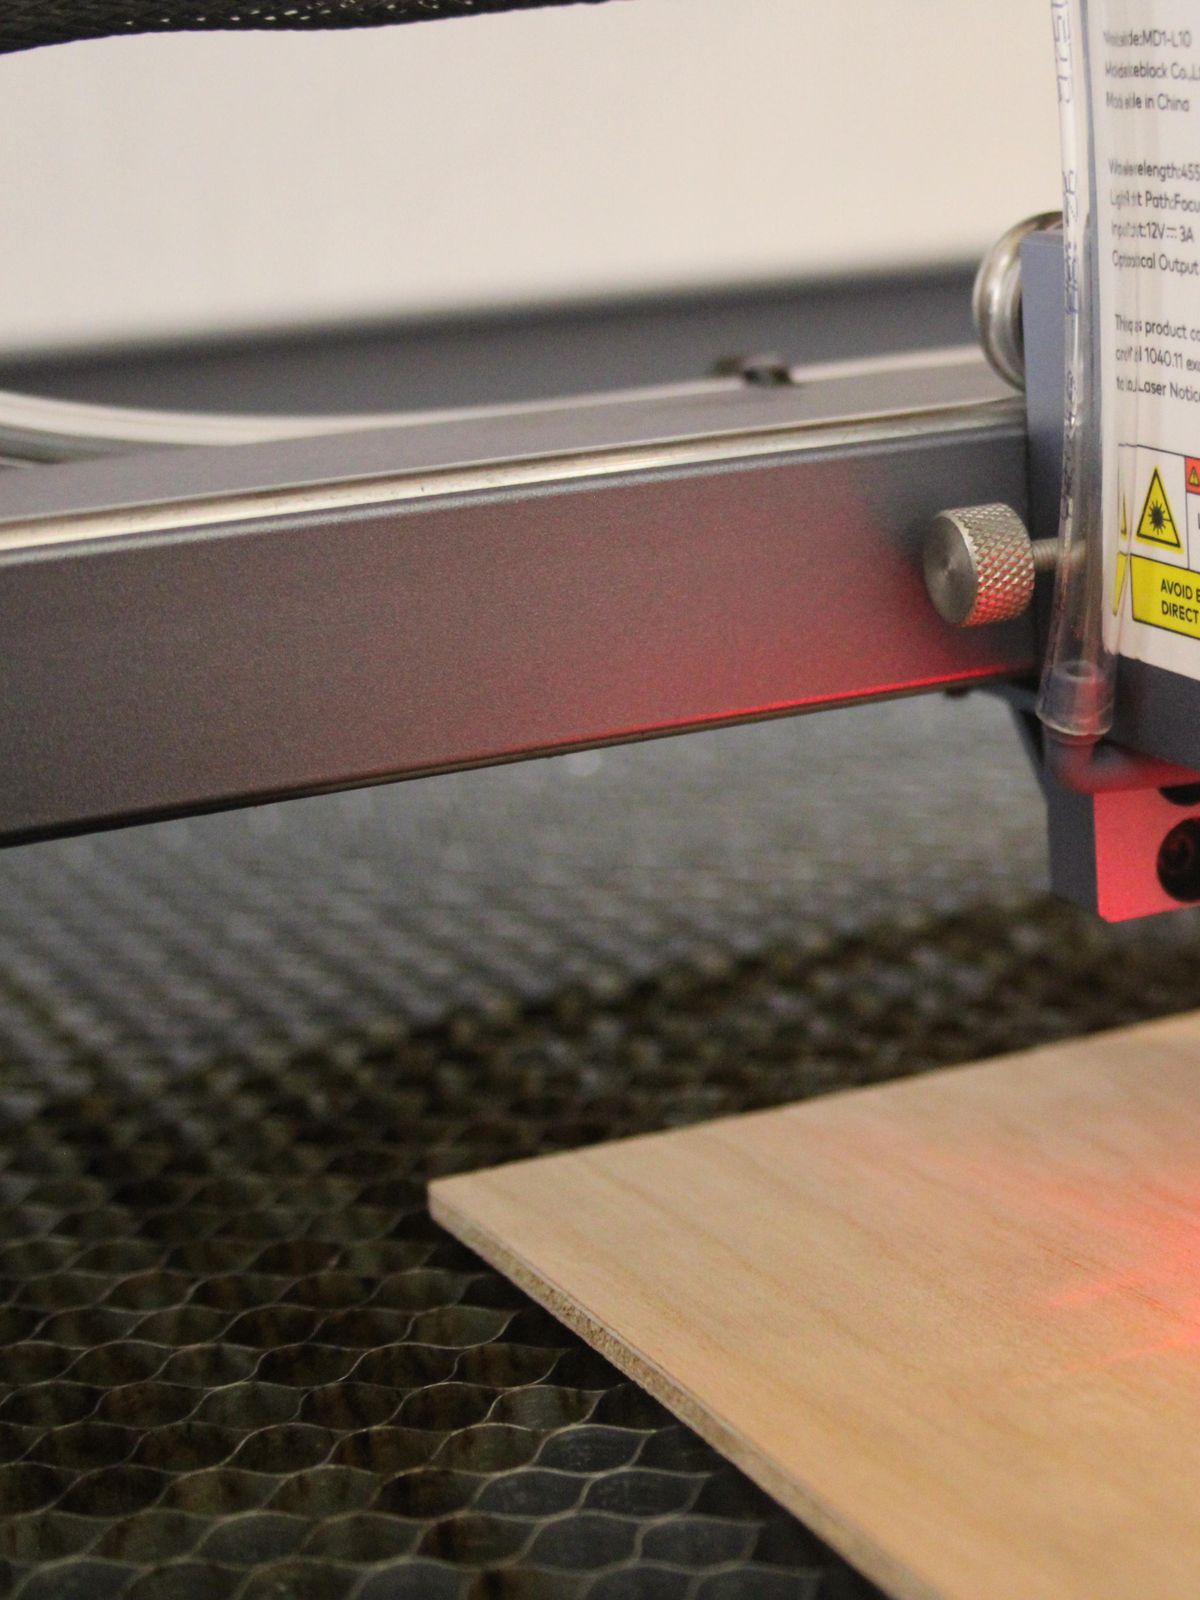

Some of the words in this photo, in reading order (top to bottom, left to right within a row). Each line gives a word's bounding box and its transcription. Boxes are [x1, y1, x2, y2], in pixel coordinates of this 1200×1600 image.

[1145, 94, 1154, 109] in
[1157, 92, 1190, 112] China
[1158, 254, 1199, 276] Output
[1145, 320, 1187, 340] product
[1145, 347, 1183, 368] 1040.11
[1160, 579, 1193, 600] AVOID
[1161, 601, 1200, 623] DIRECT
